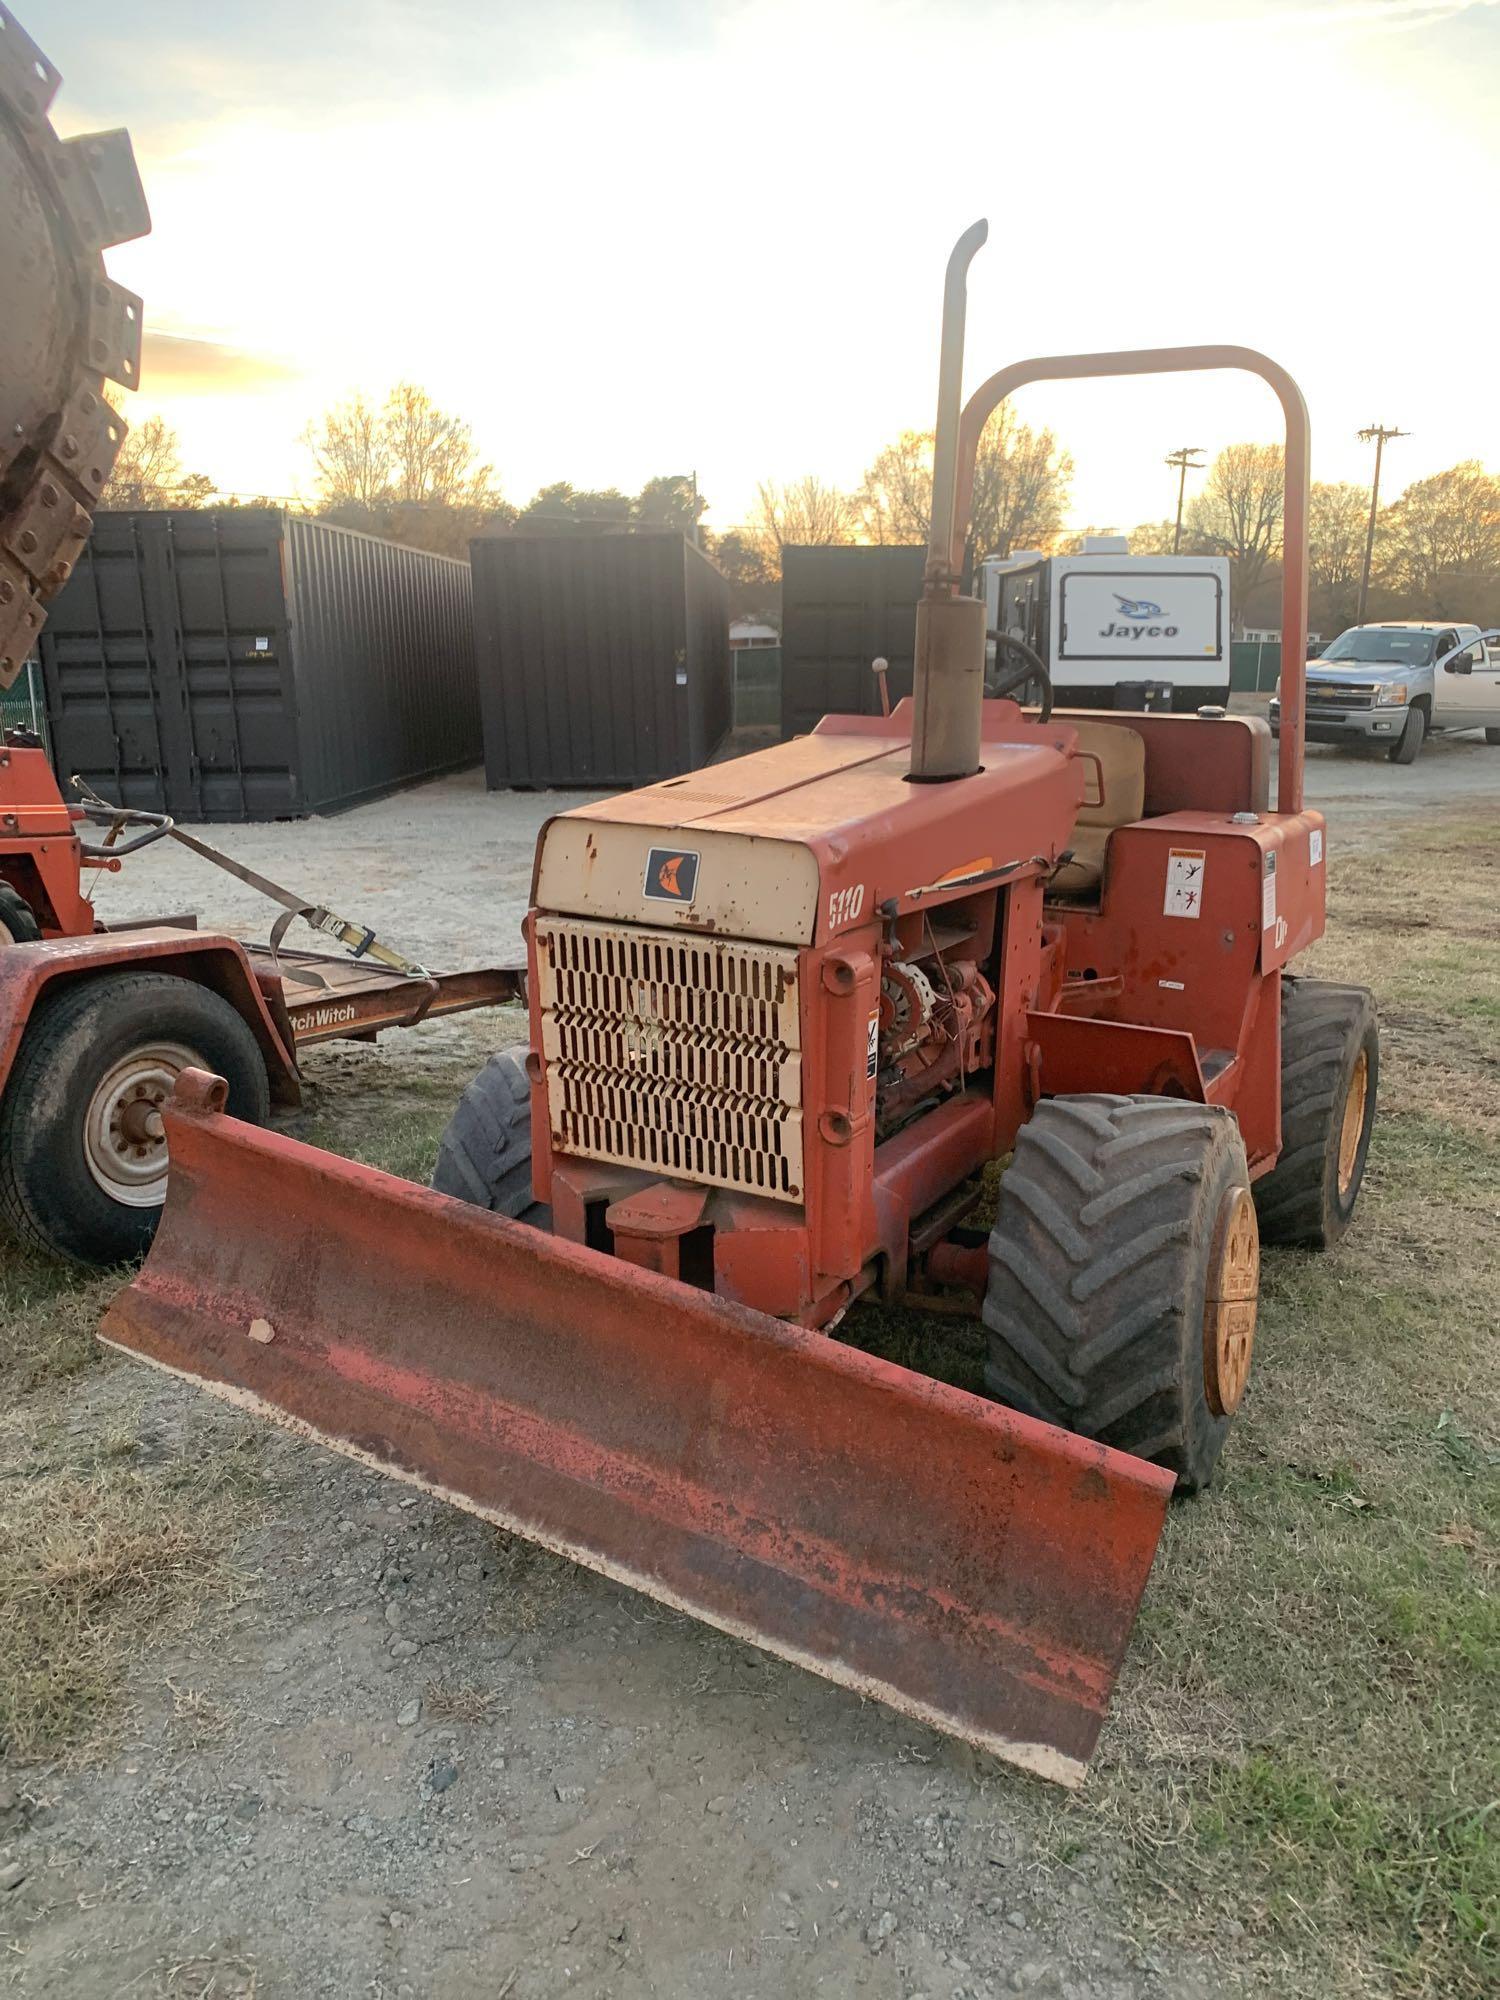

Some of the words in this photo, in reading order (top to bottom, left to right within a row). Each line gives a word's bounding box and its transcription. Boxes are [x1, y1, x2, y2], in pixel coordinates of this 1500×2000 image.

[1099, 622, 1179, 640] Jayco
[829, 884, 865, 930] 5110
[316, 1004, 355, 1026] Witch
